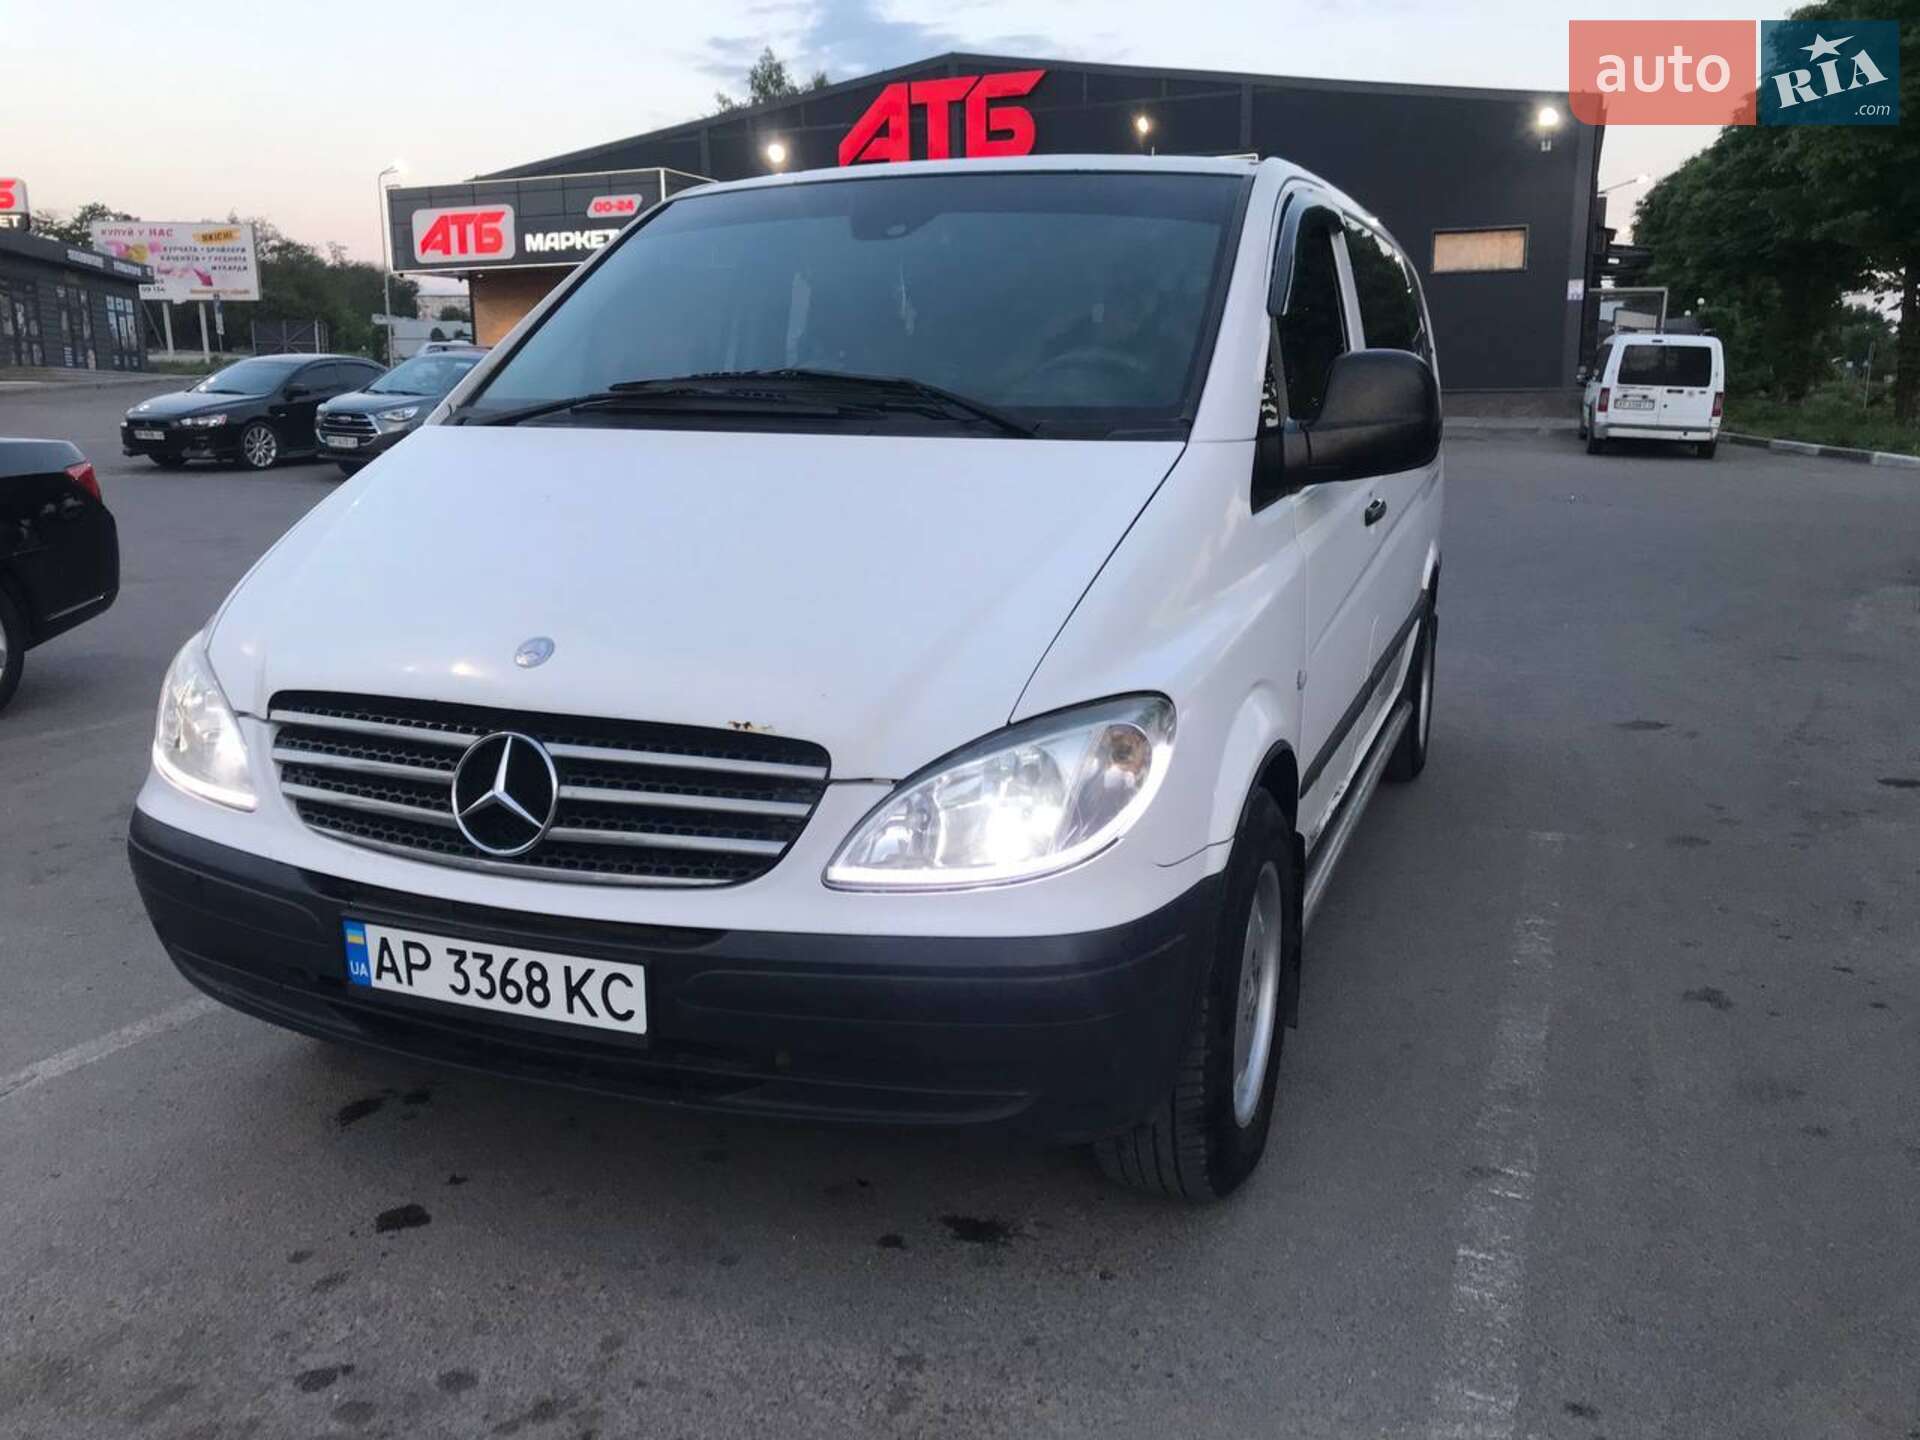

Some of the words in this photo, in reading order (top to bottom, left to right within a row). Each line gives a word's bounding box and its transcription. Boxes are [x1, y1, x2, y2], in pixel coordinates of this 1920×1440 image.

[838, 69, 1047, 168] АТБ
[593, 199, 635, 213] 00-24
[149, 228, 174, 238] НАС
[420, 210, 505, 256] АТБ
[349, 962, 369, 977] UA
[375, 936, 432, 987] AP
[446, 947, 551, 1010] 3368
[563, 965, 636, 1022] KC
